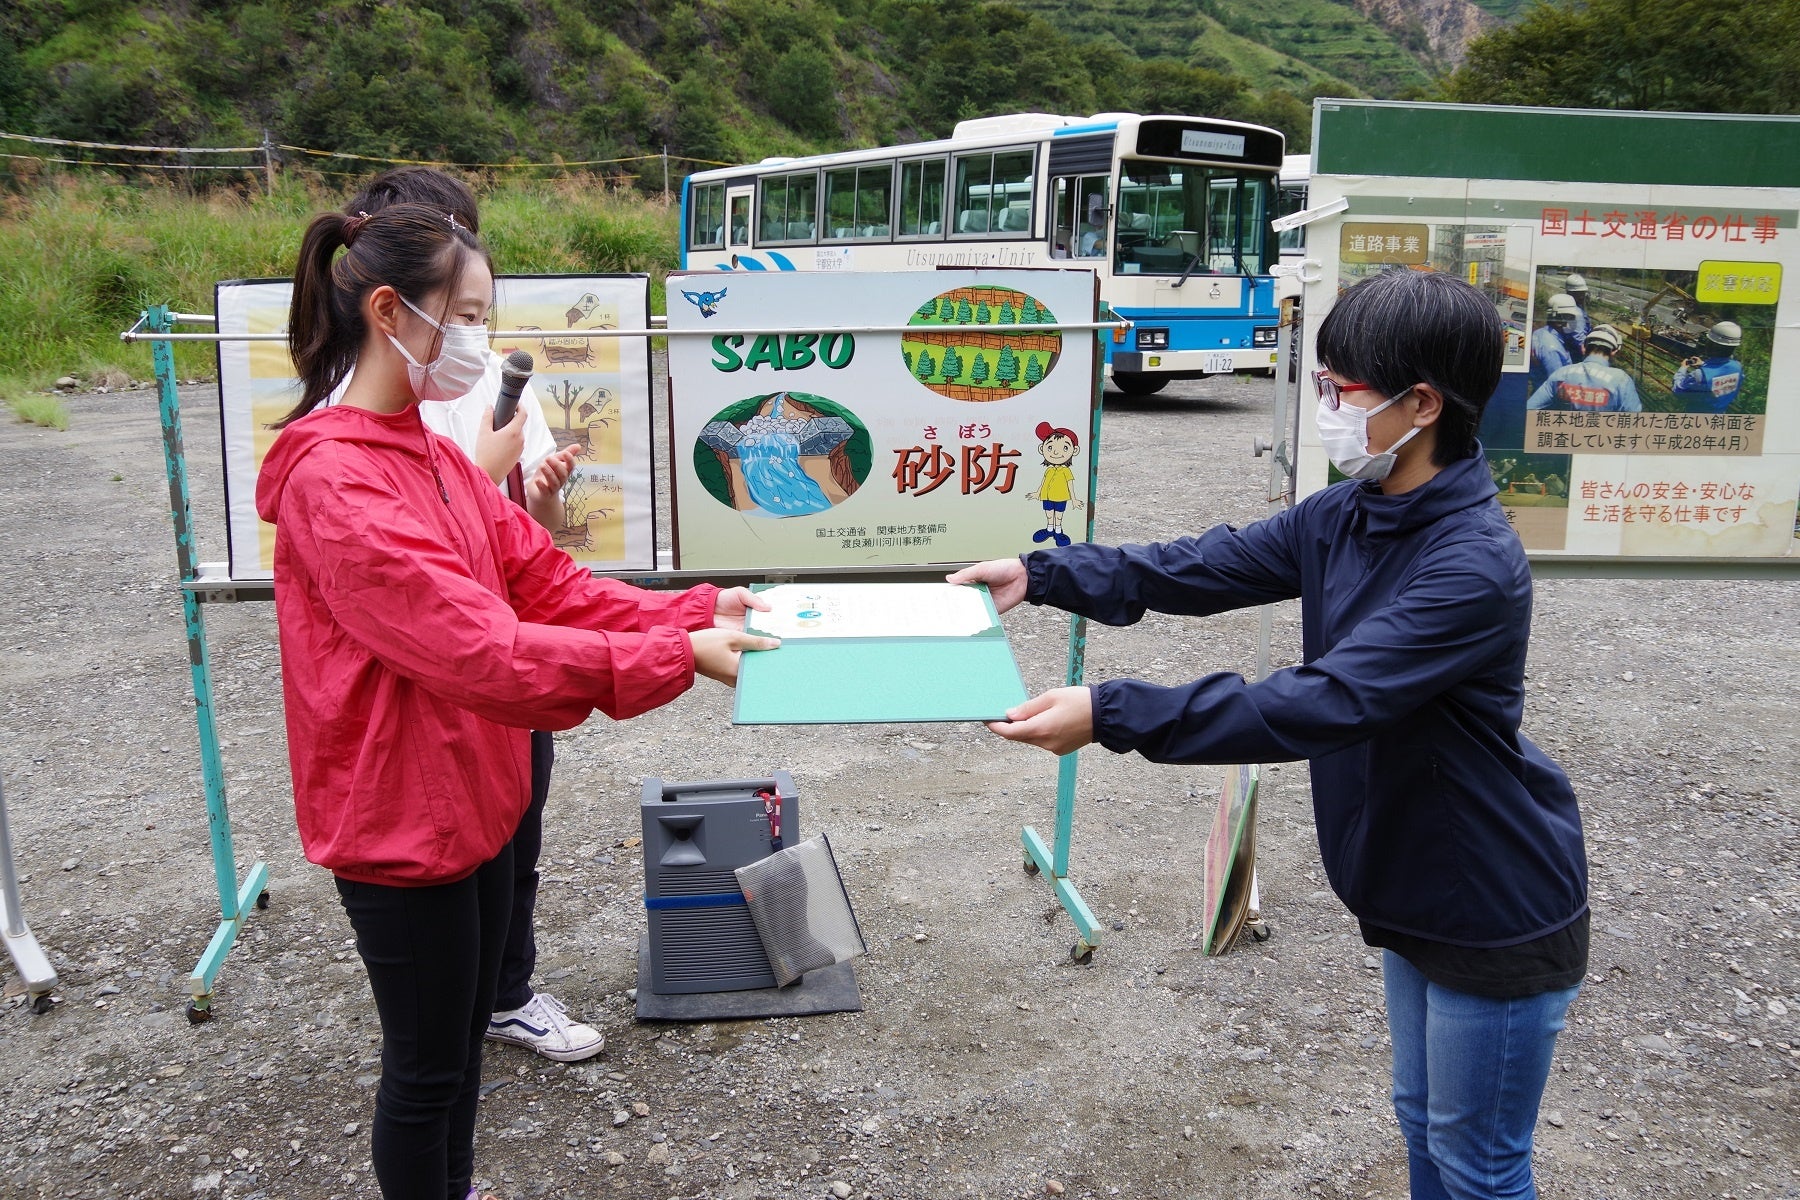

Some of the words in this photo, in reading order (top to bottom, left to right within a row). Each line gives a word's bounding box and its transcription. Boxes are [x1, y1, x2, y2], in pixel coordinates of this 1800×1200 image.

[1541, 207, 1781, 244] 国土交通省の仕事
[1349, 233, 1421, 254] 道路事業
[1704, 273, 1774, 293] 災害対応
[712, 332, 855, 373] SABO
[1536, 411, 1757, 431] 熊本地震で崩れた危ない斜面を
[923, 425, 938, 440] さ
[958, 424, 992, 439] ぼう
[590, 474, 615, 483] 鹿よけ
[892, 442, 1022, 497] 砂防
[602, 484, 623, 493] ネット
[1580, 480, 1756, 500] 皆さんの安全・安心な
[1583, 503, 1747, 523] 生活を守る仕事です
[816, 526, 867, 538] 国土交通省
[876, 523, 947, 536] 関東地方整備局
[841, 535, 932, 549] 渡良瀬川河川事務所
